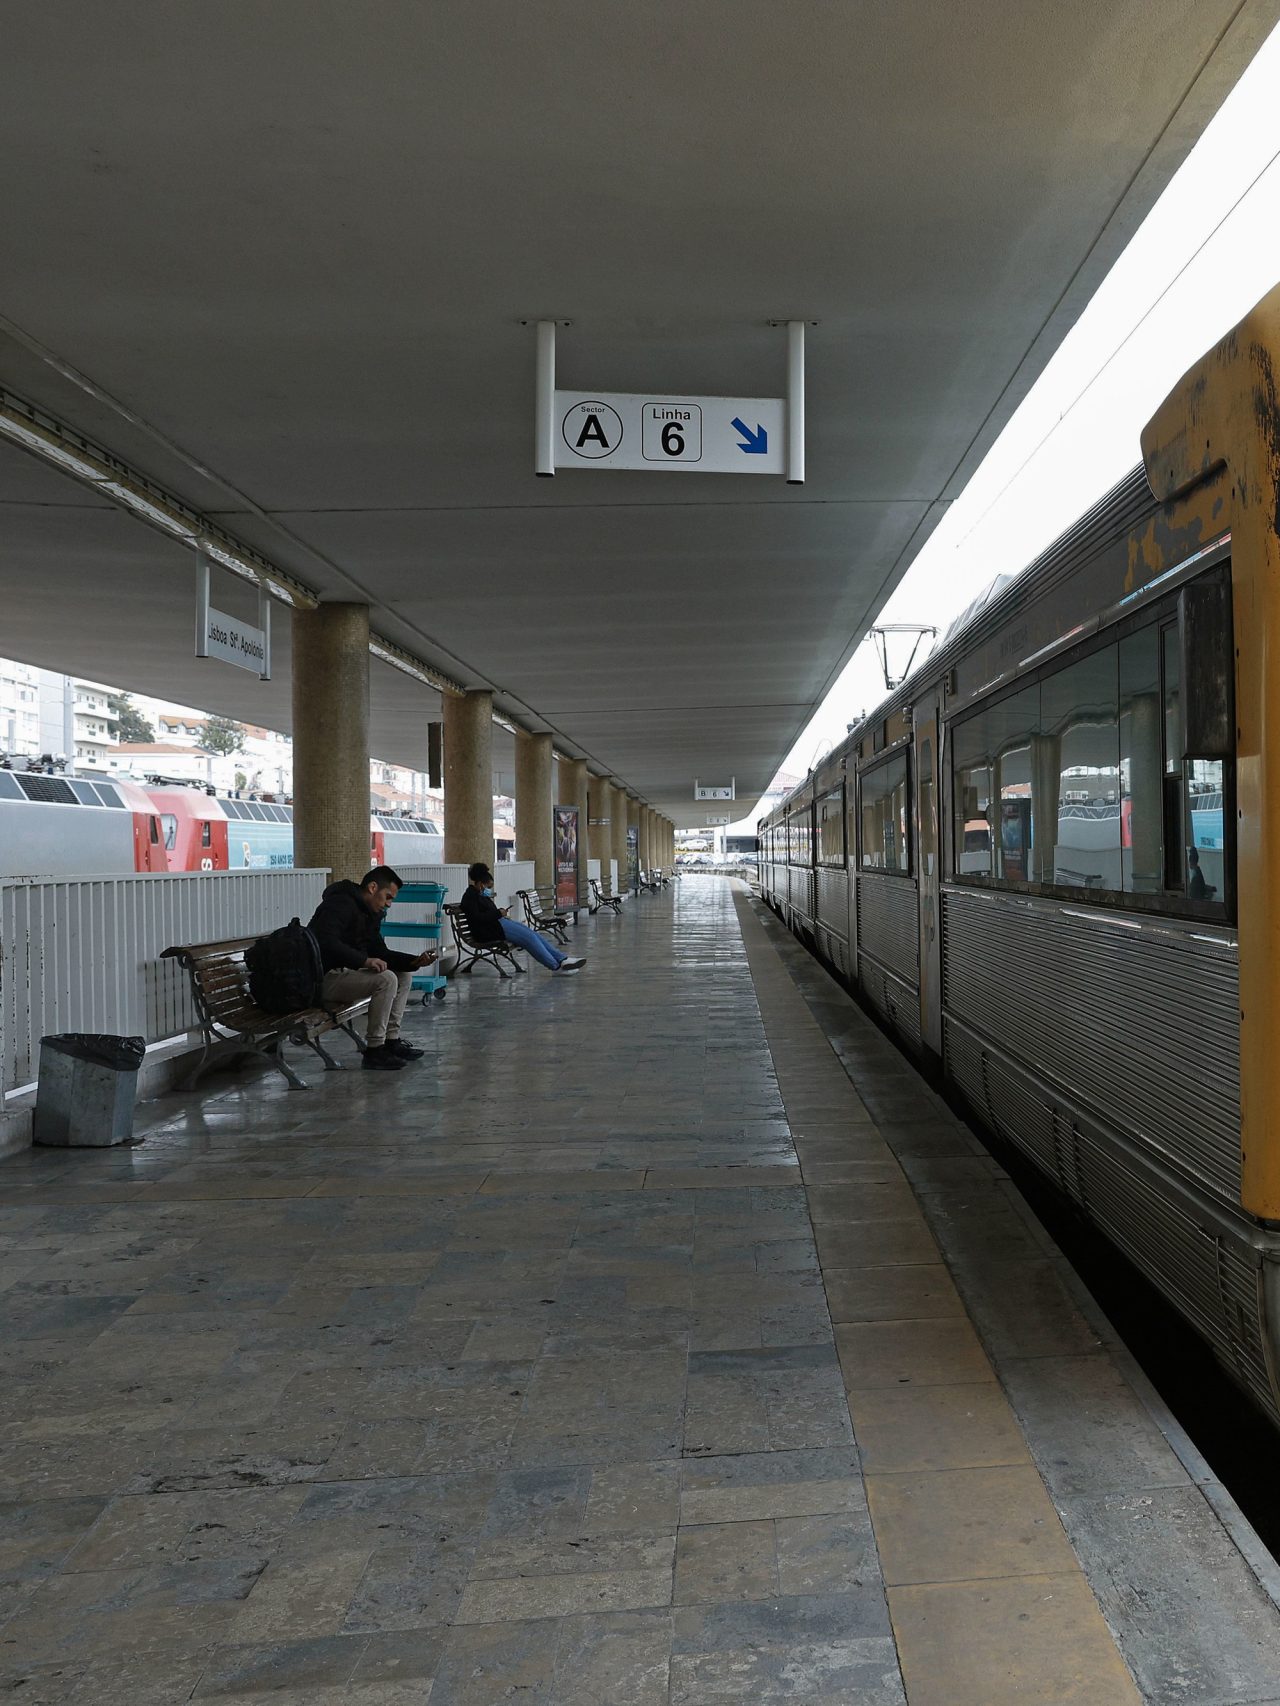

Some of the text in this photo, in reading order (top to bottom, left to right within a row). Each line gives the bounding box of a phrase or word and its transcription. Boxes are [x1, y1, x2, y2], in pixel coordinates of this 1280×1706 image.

[580, 405, 606, 413] Sector
[652, 408, 691, 420] Linha
[575, 414, 610, 448] A
[661, 421, 685, 456] 6
